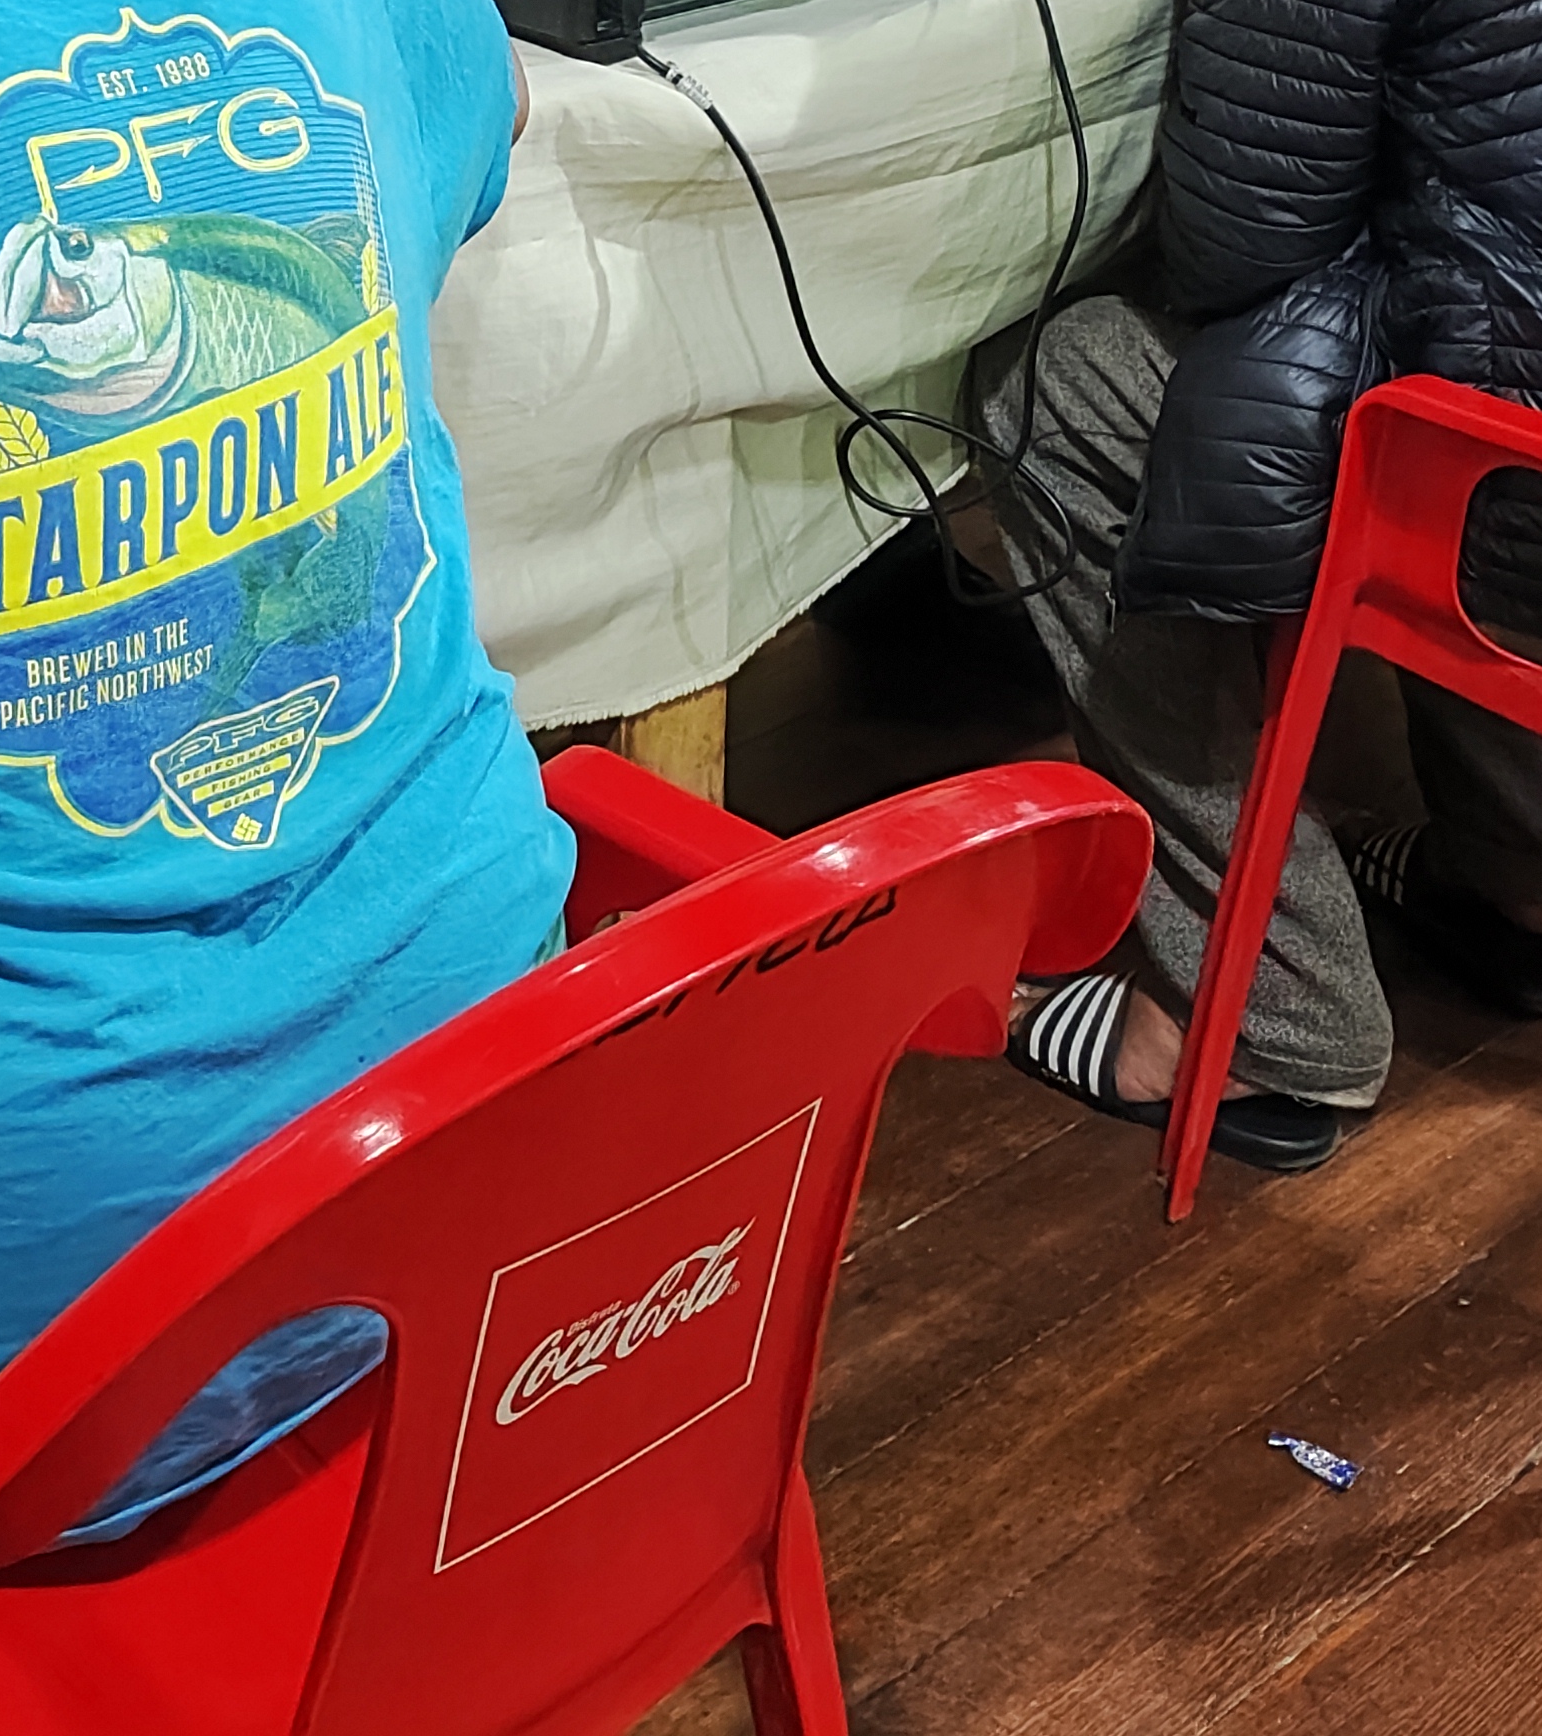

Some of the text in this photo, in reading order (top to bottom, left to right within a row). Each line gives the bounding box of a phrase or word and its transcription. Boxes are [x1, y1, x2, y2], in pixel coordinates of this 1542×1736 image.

[96, 52, 211, 100] EST. 1938
[26, 87, 312, 224] PFG
[325, 334, 393, 488] ALE
[0, 644, 214, 731] PACIFIC NORTHWEST
[26, 617, 189, 688] BREWED IN THE
[166, 695, 320, 776] PFG
[181, 731, 301, 784] PERFORMANCE
[211, 764, 273, 794] FISHING
[223, 787, 263, 810] GEAR
[495, 1213, 757, 1425] Coca-Cola
